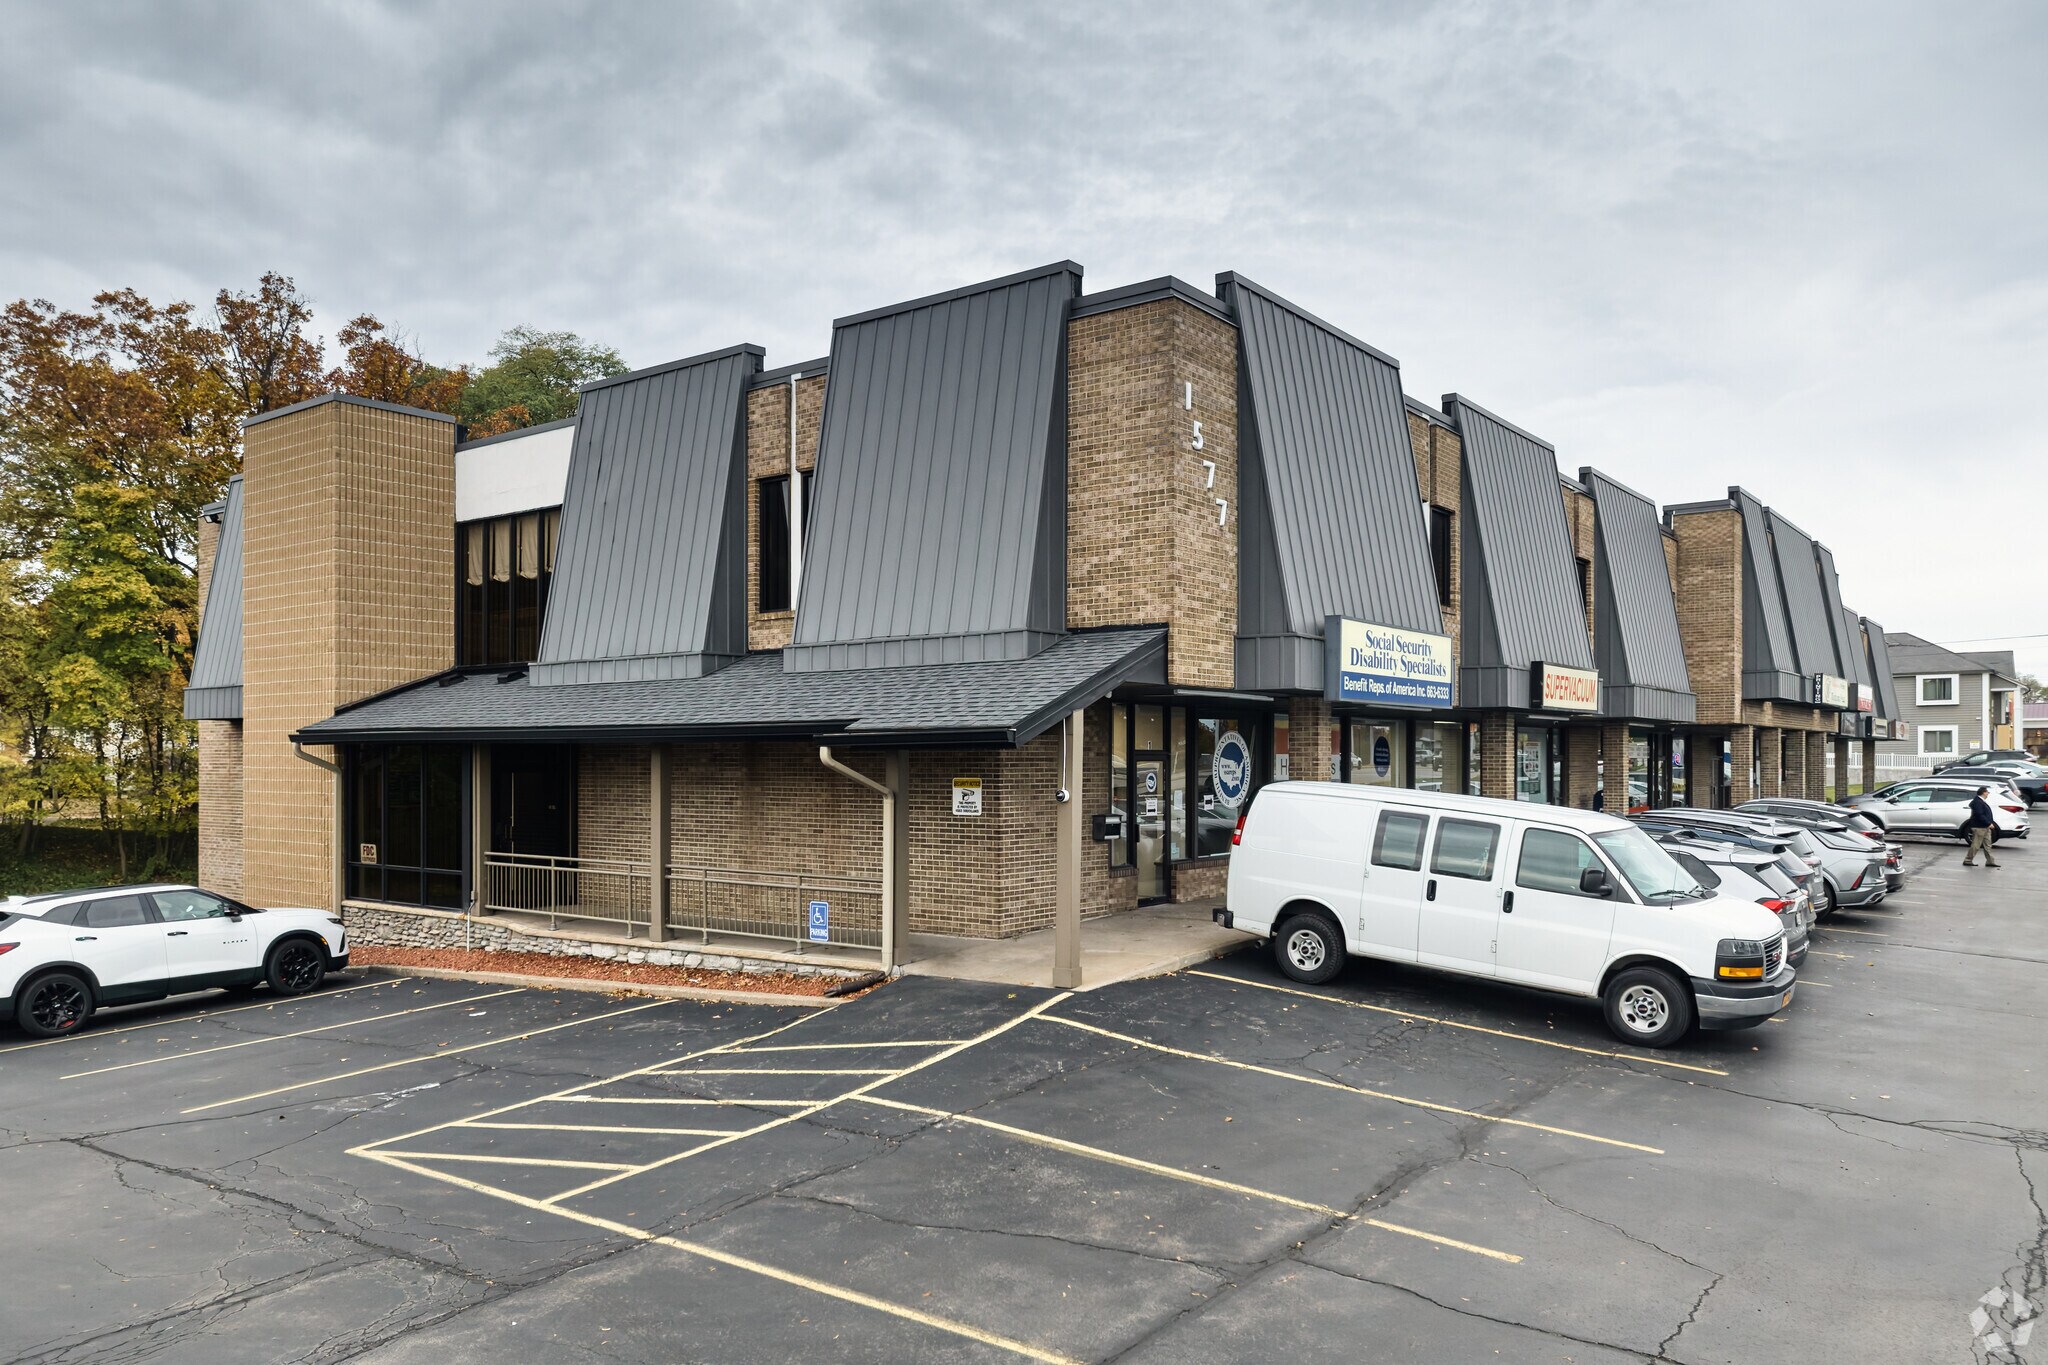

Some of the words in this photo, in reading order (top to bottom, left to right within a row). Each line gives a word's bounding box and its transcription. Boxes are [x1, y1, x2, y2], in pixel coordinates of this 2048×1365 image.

[1184, 382, 1228, 527] 1577
[1365, 630, 1395, 652] Social
[1396, 635, 1432, 657] Security
[1350, 647, 1398, 676] Disability
[1400, 655, 1447, 677] Specialists
[1343, 676, 1368, 692] Benefit
[1368, 678, 1385, 696] Reps.
[1385, 681, 1392, 694] of
[1392, 682, 1417, 697] America
[1416, 684, 1426, 698] Inc.
[1426, 685, 1449, 700] 663-6333
[1545, 673, 1596, 703] SUPERVACUUM
